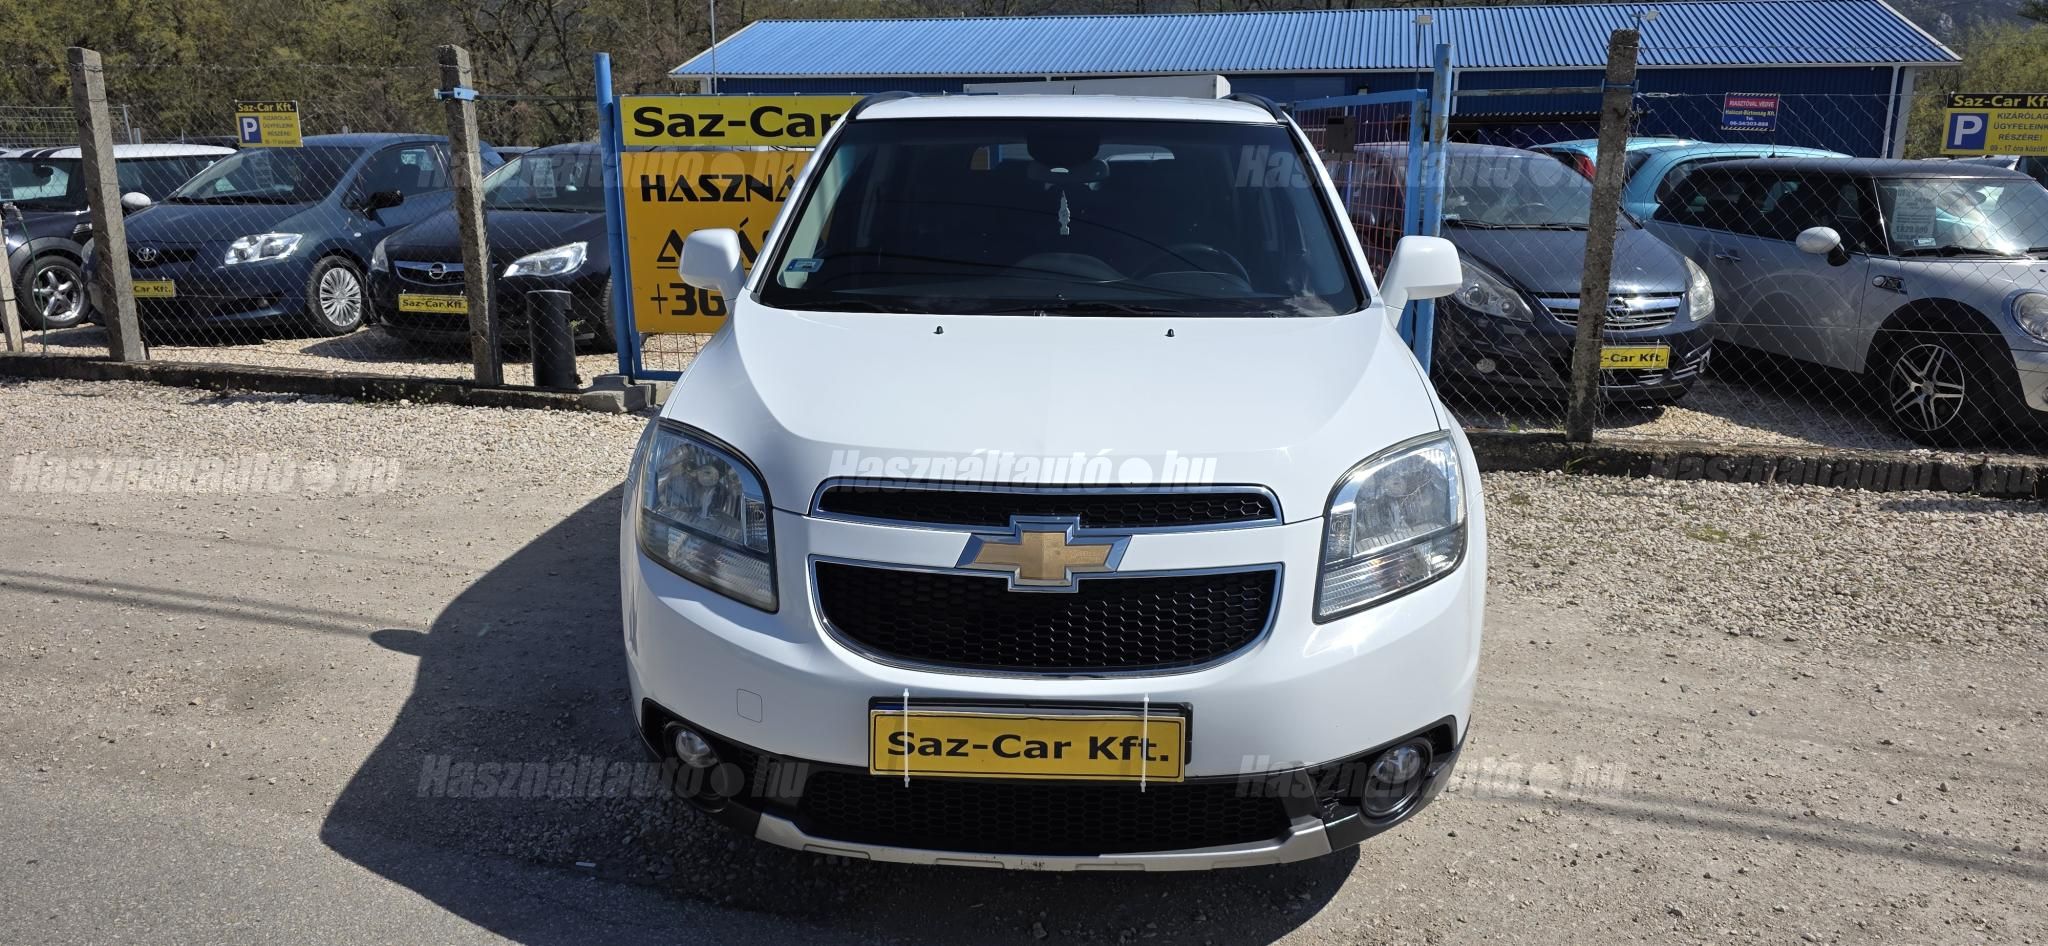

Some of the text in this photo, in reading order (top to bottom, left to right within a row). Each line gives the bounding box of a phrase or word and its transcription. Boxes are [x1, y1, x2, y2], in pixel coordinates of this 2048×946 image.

[238, 102, 295, 112] Saz-Car Kft.
[1953, 95, 2048, 108] Saz-Car Kf
[242, 117, 258, 141] P
[633, 105, 840, 138] Saz-Car
[1953, 115, 1983, 146] P
[1639, 353, 1665, 362] Kft.
[887, 731, 1169, 763] Saz-Car Kft.
